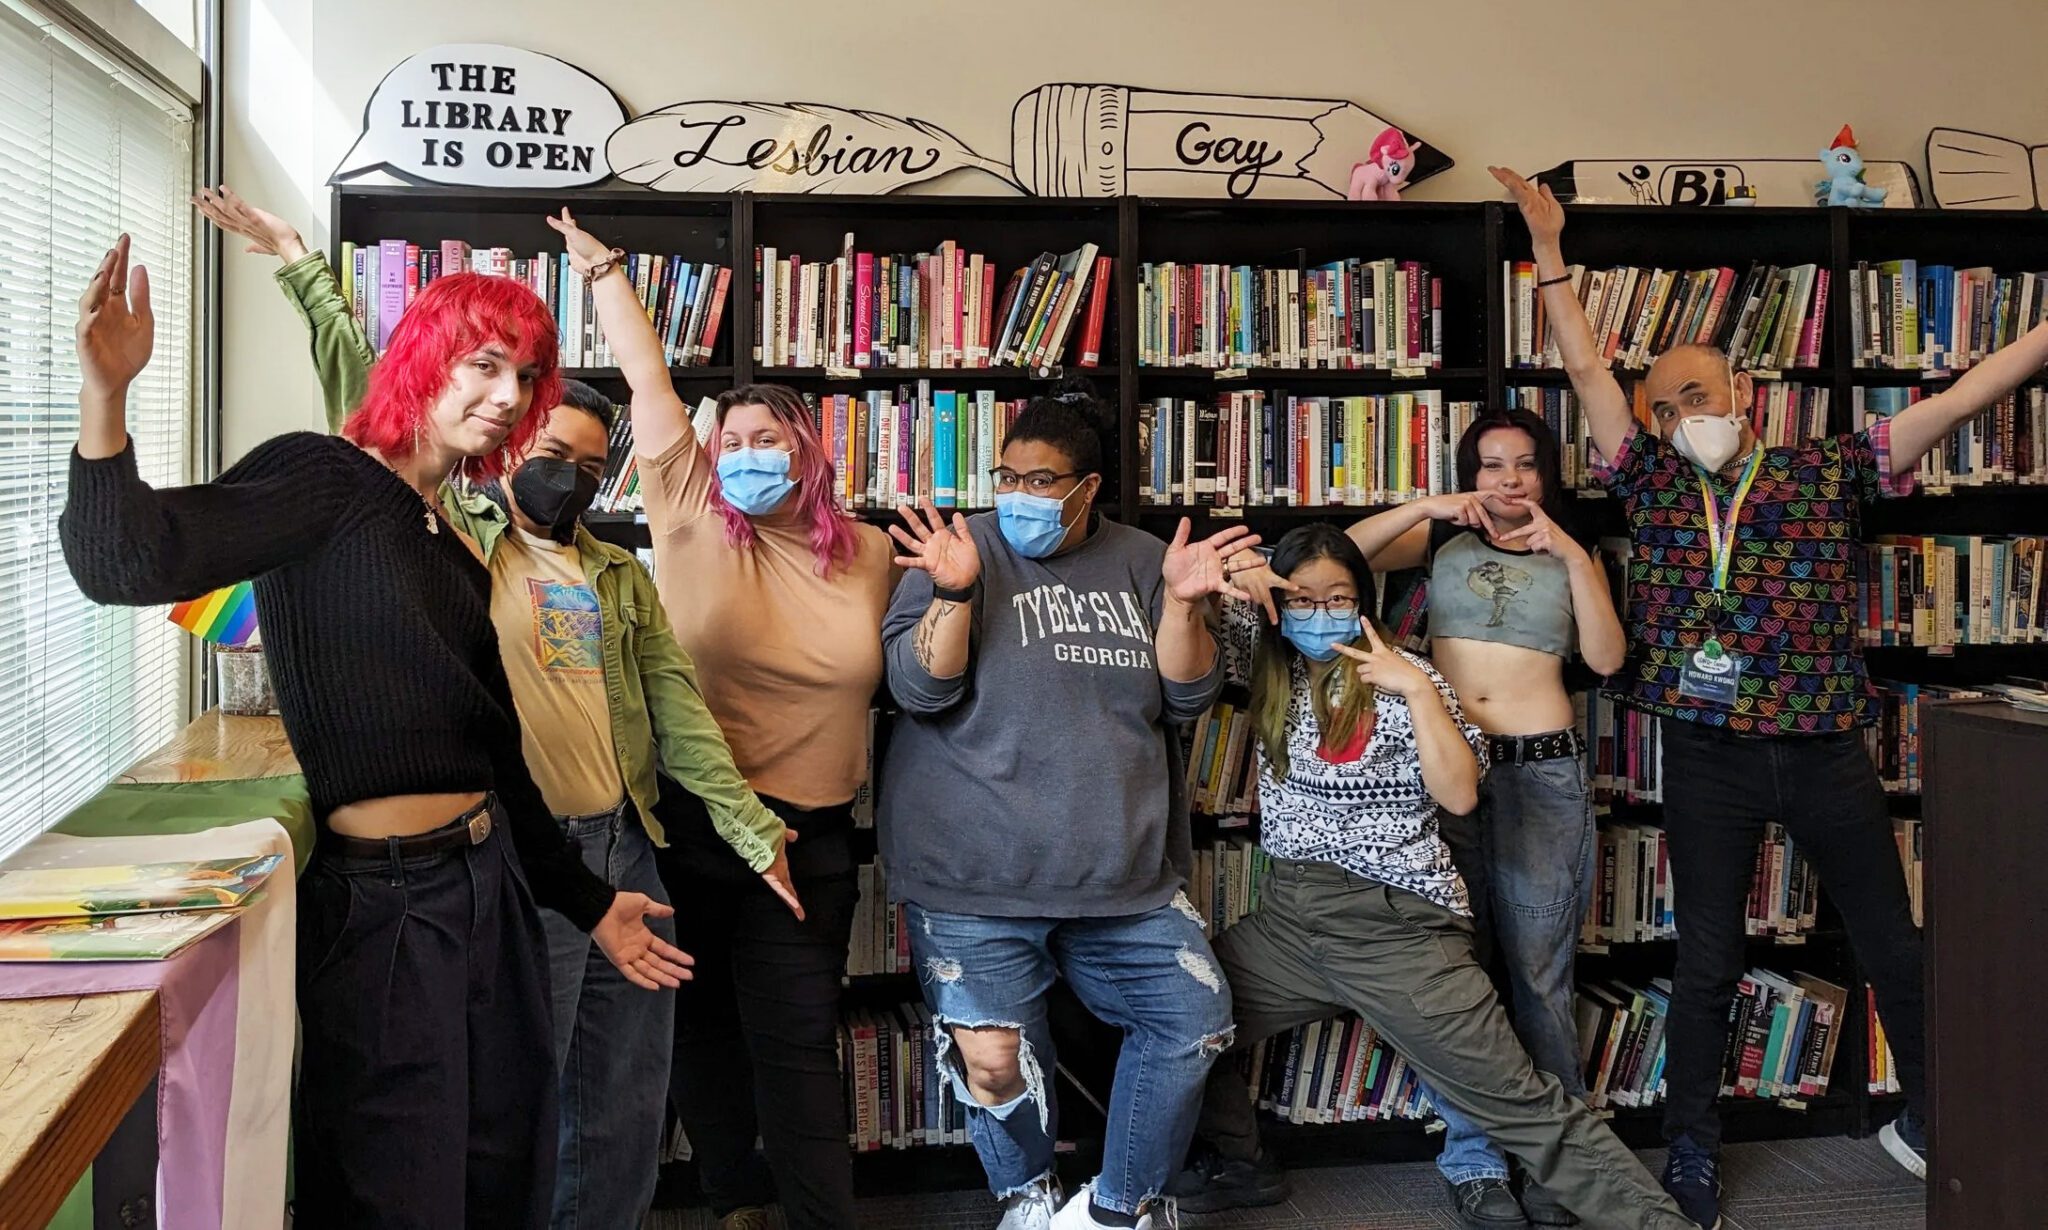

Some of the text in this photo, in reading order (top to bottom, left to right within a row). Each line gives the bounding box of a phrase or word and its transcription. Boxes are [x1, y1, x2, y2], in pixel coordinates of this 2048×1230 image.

[431, 63, 515, 95] THE
[401, 100, 572, 136] LIBRARY
[422, 139, 594, 173] IS OPEN
[673, 115, 940, 176] Lesbian
[1176, 122, 1282, 199] Gay
[1671, 168, 1725, 205] Bi
[356, 254, 364, 317] QUEER MOBILIZATIONS
[1054, 284, 1063, 295] TAKE
[1328, 278, 1336, 307] JUSTICE
[1615, 272, 1624, 287] THE
[775, 288, 783, 339] COOK BOOK
[859, 283, 871, 345] Screened Out
[1894, 278, 1903, 331] INSURRECTO
[858, 410, 866, 437] WILDE
[900, 421, 909, 449] GUIDE
[982, 402, 990, 436] BEAUVOIR
[1254, 409, 1262, 431] queer
[1336, 406, 1344, 438] Fairyland
[879, 417, 890, 470] ONE MORE KISS
[1995, 558, 2003, 600] FAME GAME
[1054, 643, 1152, 669] GEORGIA
[1688, 670, 1735, 686] HOWARD KWONG
[1605, 857, 1615, 866] GAY
[881, 1039, 890, 1098] BLACK DEATH
[1286, 1041, 1300, 1068] Serving
[1351, 1052, 1367, 1089] MARTIN
[1810, 1050, 1822, 1074] FIERCE
[855, 1040, 869, 1135] AIDS IN AMERICA
[1281, 1076, 1293, 1102] Silence
